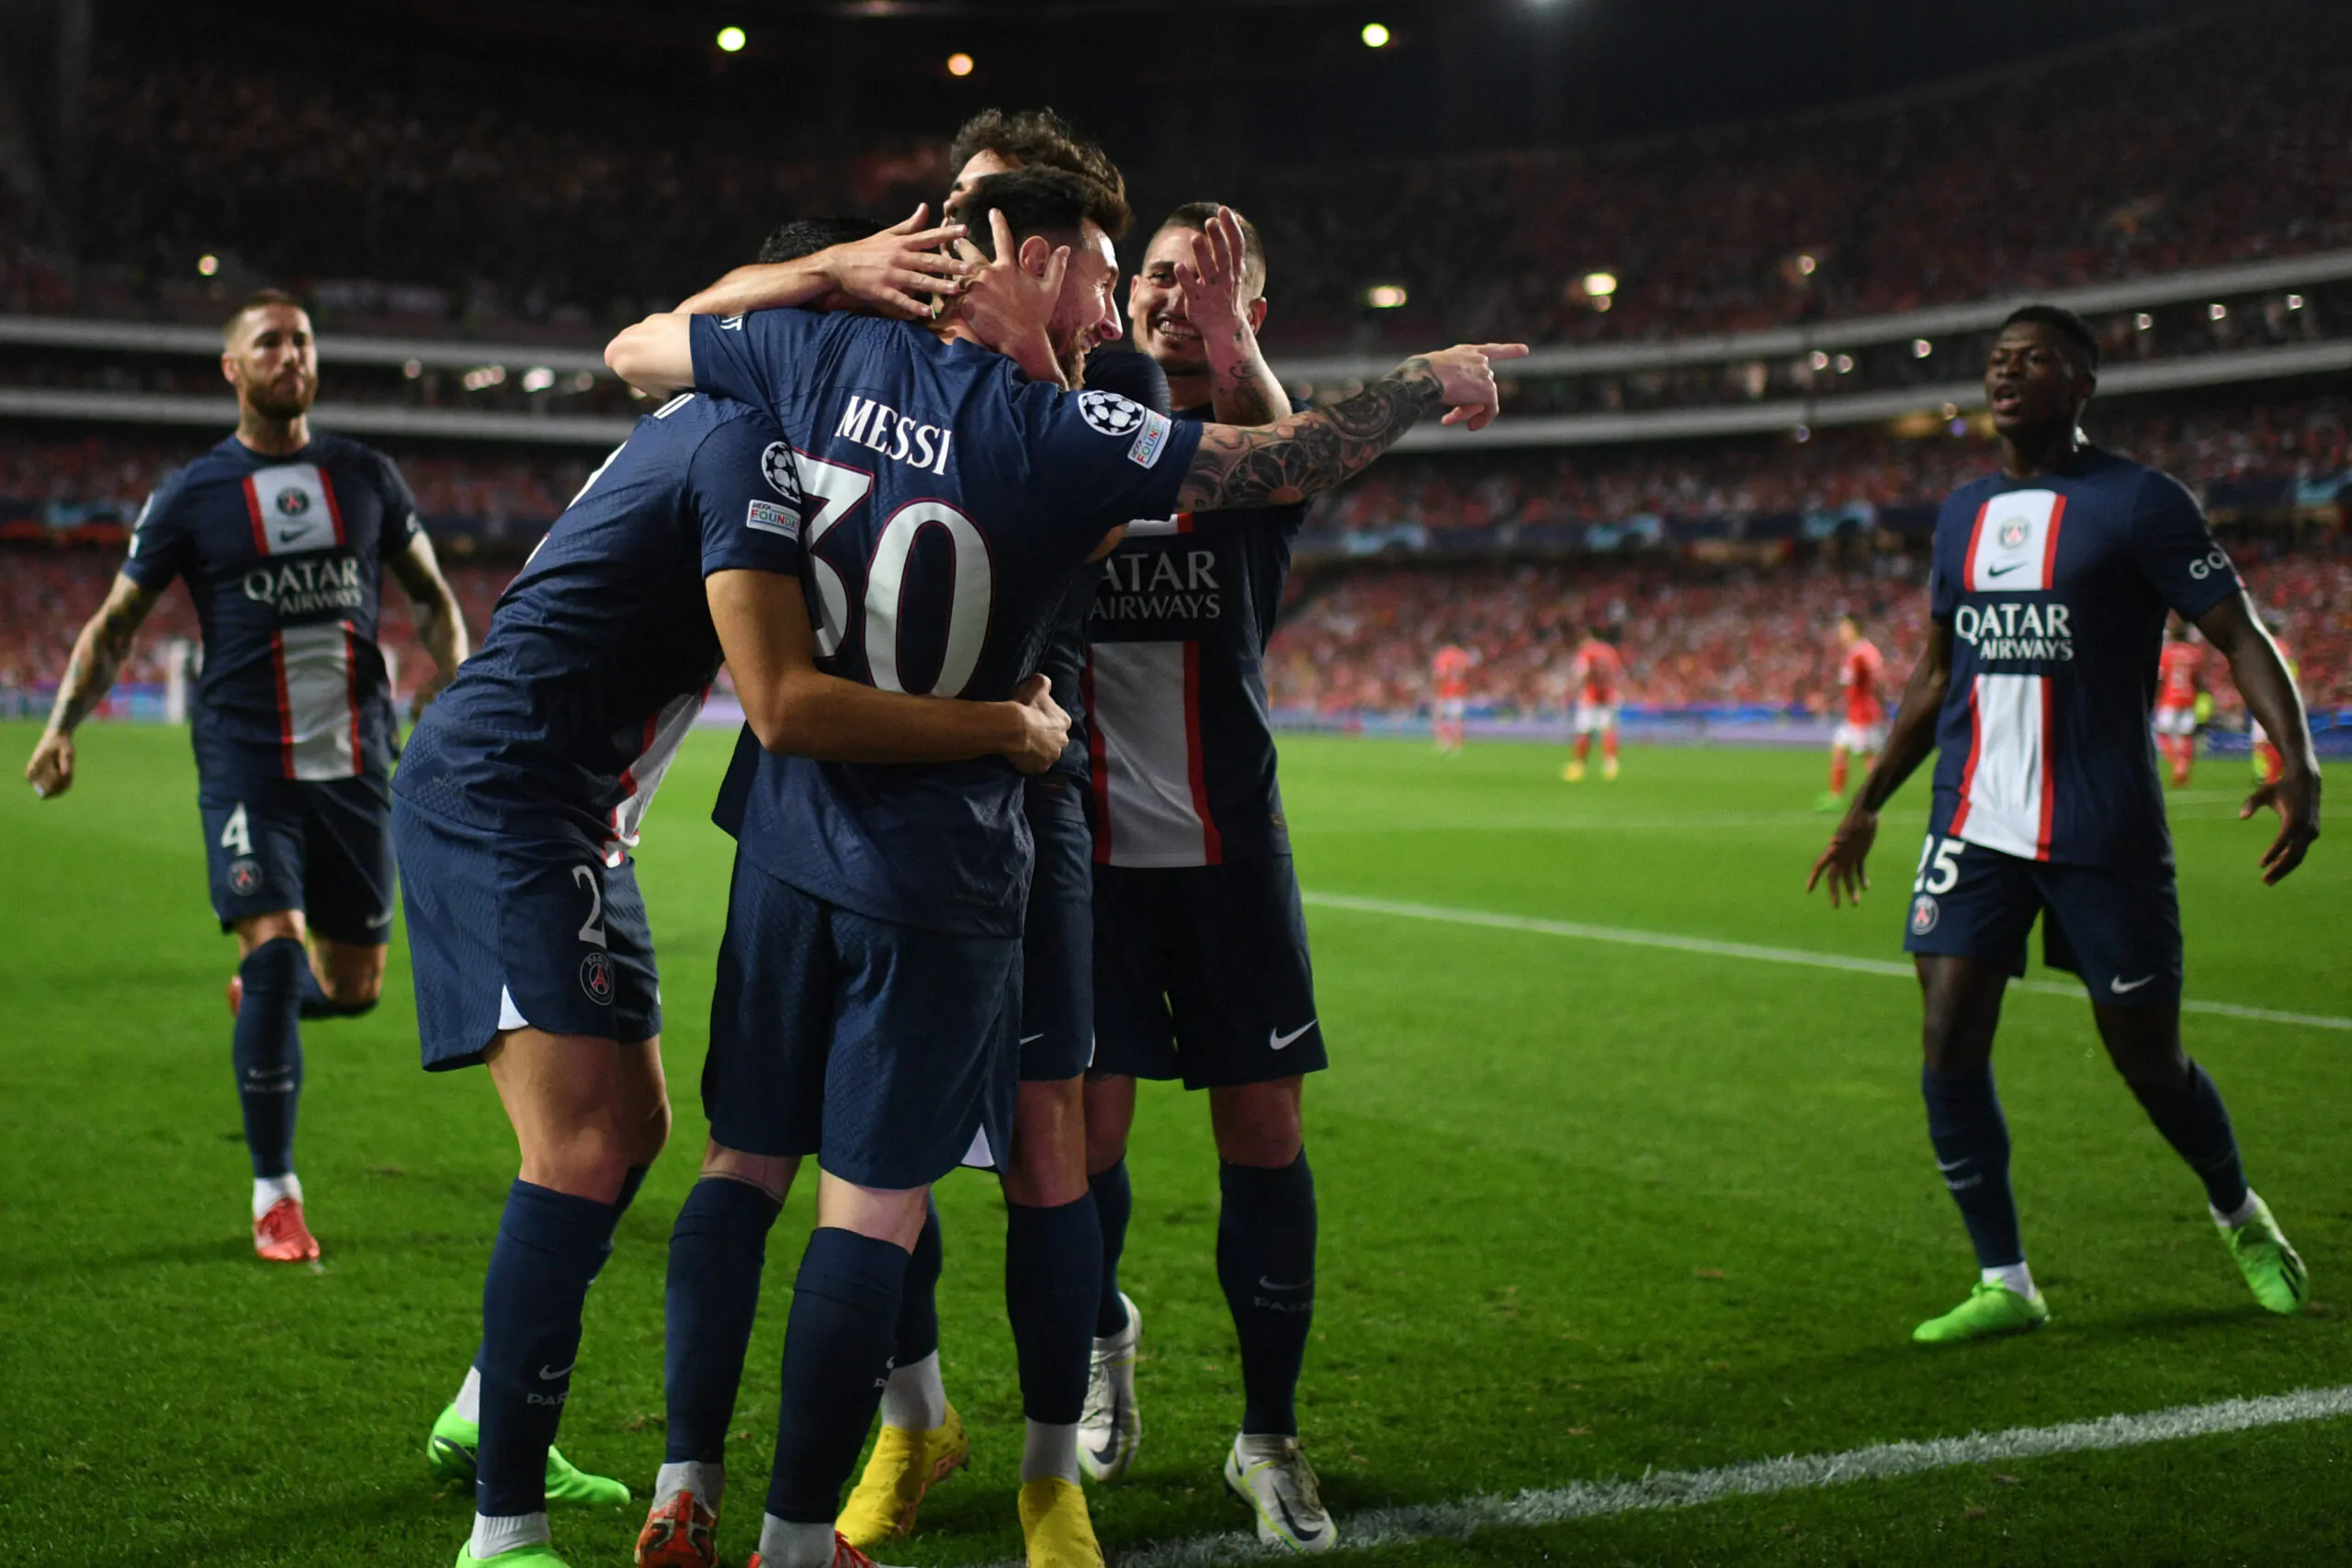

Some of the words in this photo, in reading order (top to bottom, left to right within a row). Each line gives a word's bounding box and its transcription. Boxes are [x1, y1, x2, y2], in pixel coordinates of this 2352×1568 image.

[834, 395, 952, 476] MESSI
[243, 557, 358, 605] QATAR
[1101, 550, 1220, 592] ATAR
[278, 588, 362, 617] AIRWAYS
[1089, 594, 1221, 621] AIRWAYS
[1955, 603, 2073, 646] QATAR
[1980, 638, 2075, 660] AIRWAYS
[220, 801, 254, 857] 4
[571, 864, 607, 948] 2
